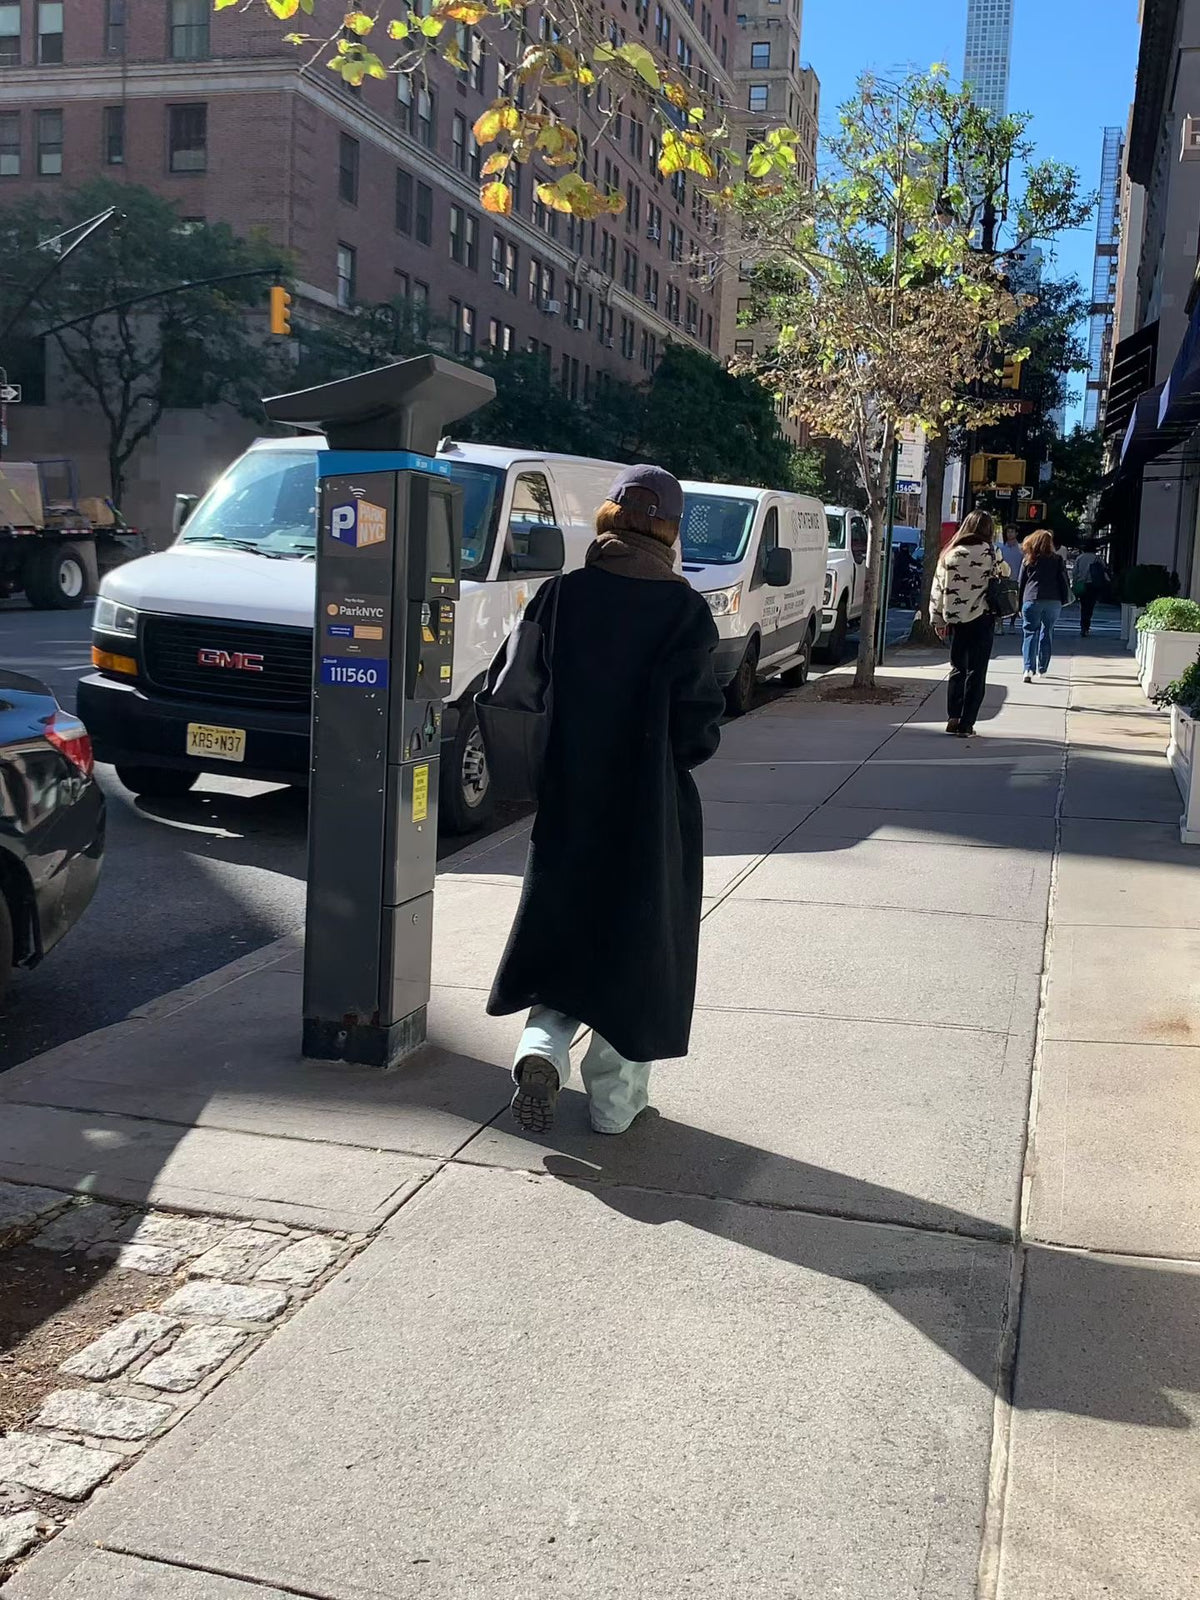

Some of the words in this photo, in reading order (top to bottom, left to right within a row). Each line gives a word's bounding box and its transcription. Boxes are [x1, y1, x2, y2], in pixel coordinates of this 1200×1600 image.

[896, 484, 912, 492] 1560
[332, 505, 355, 538] P
[359, 521, 385, 542] NYC
[340, 605, 384, 617] ParkNYC
[197, 648, 264, 671] GMC
[330, 667, 377, 684] 111560
[192, 731, 213, 749] XRS
[220, 735, 242, 752] N37
